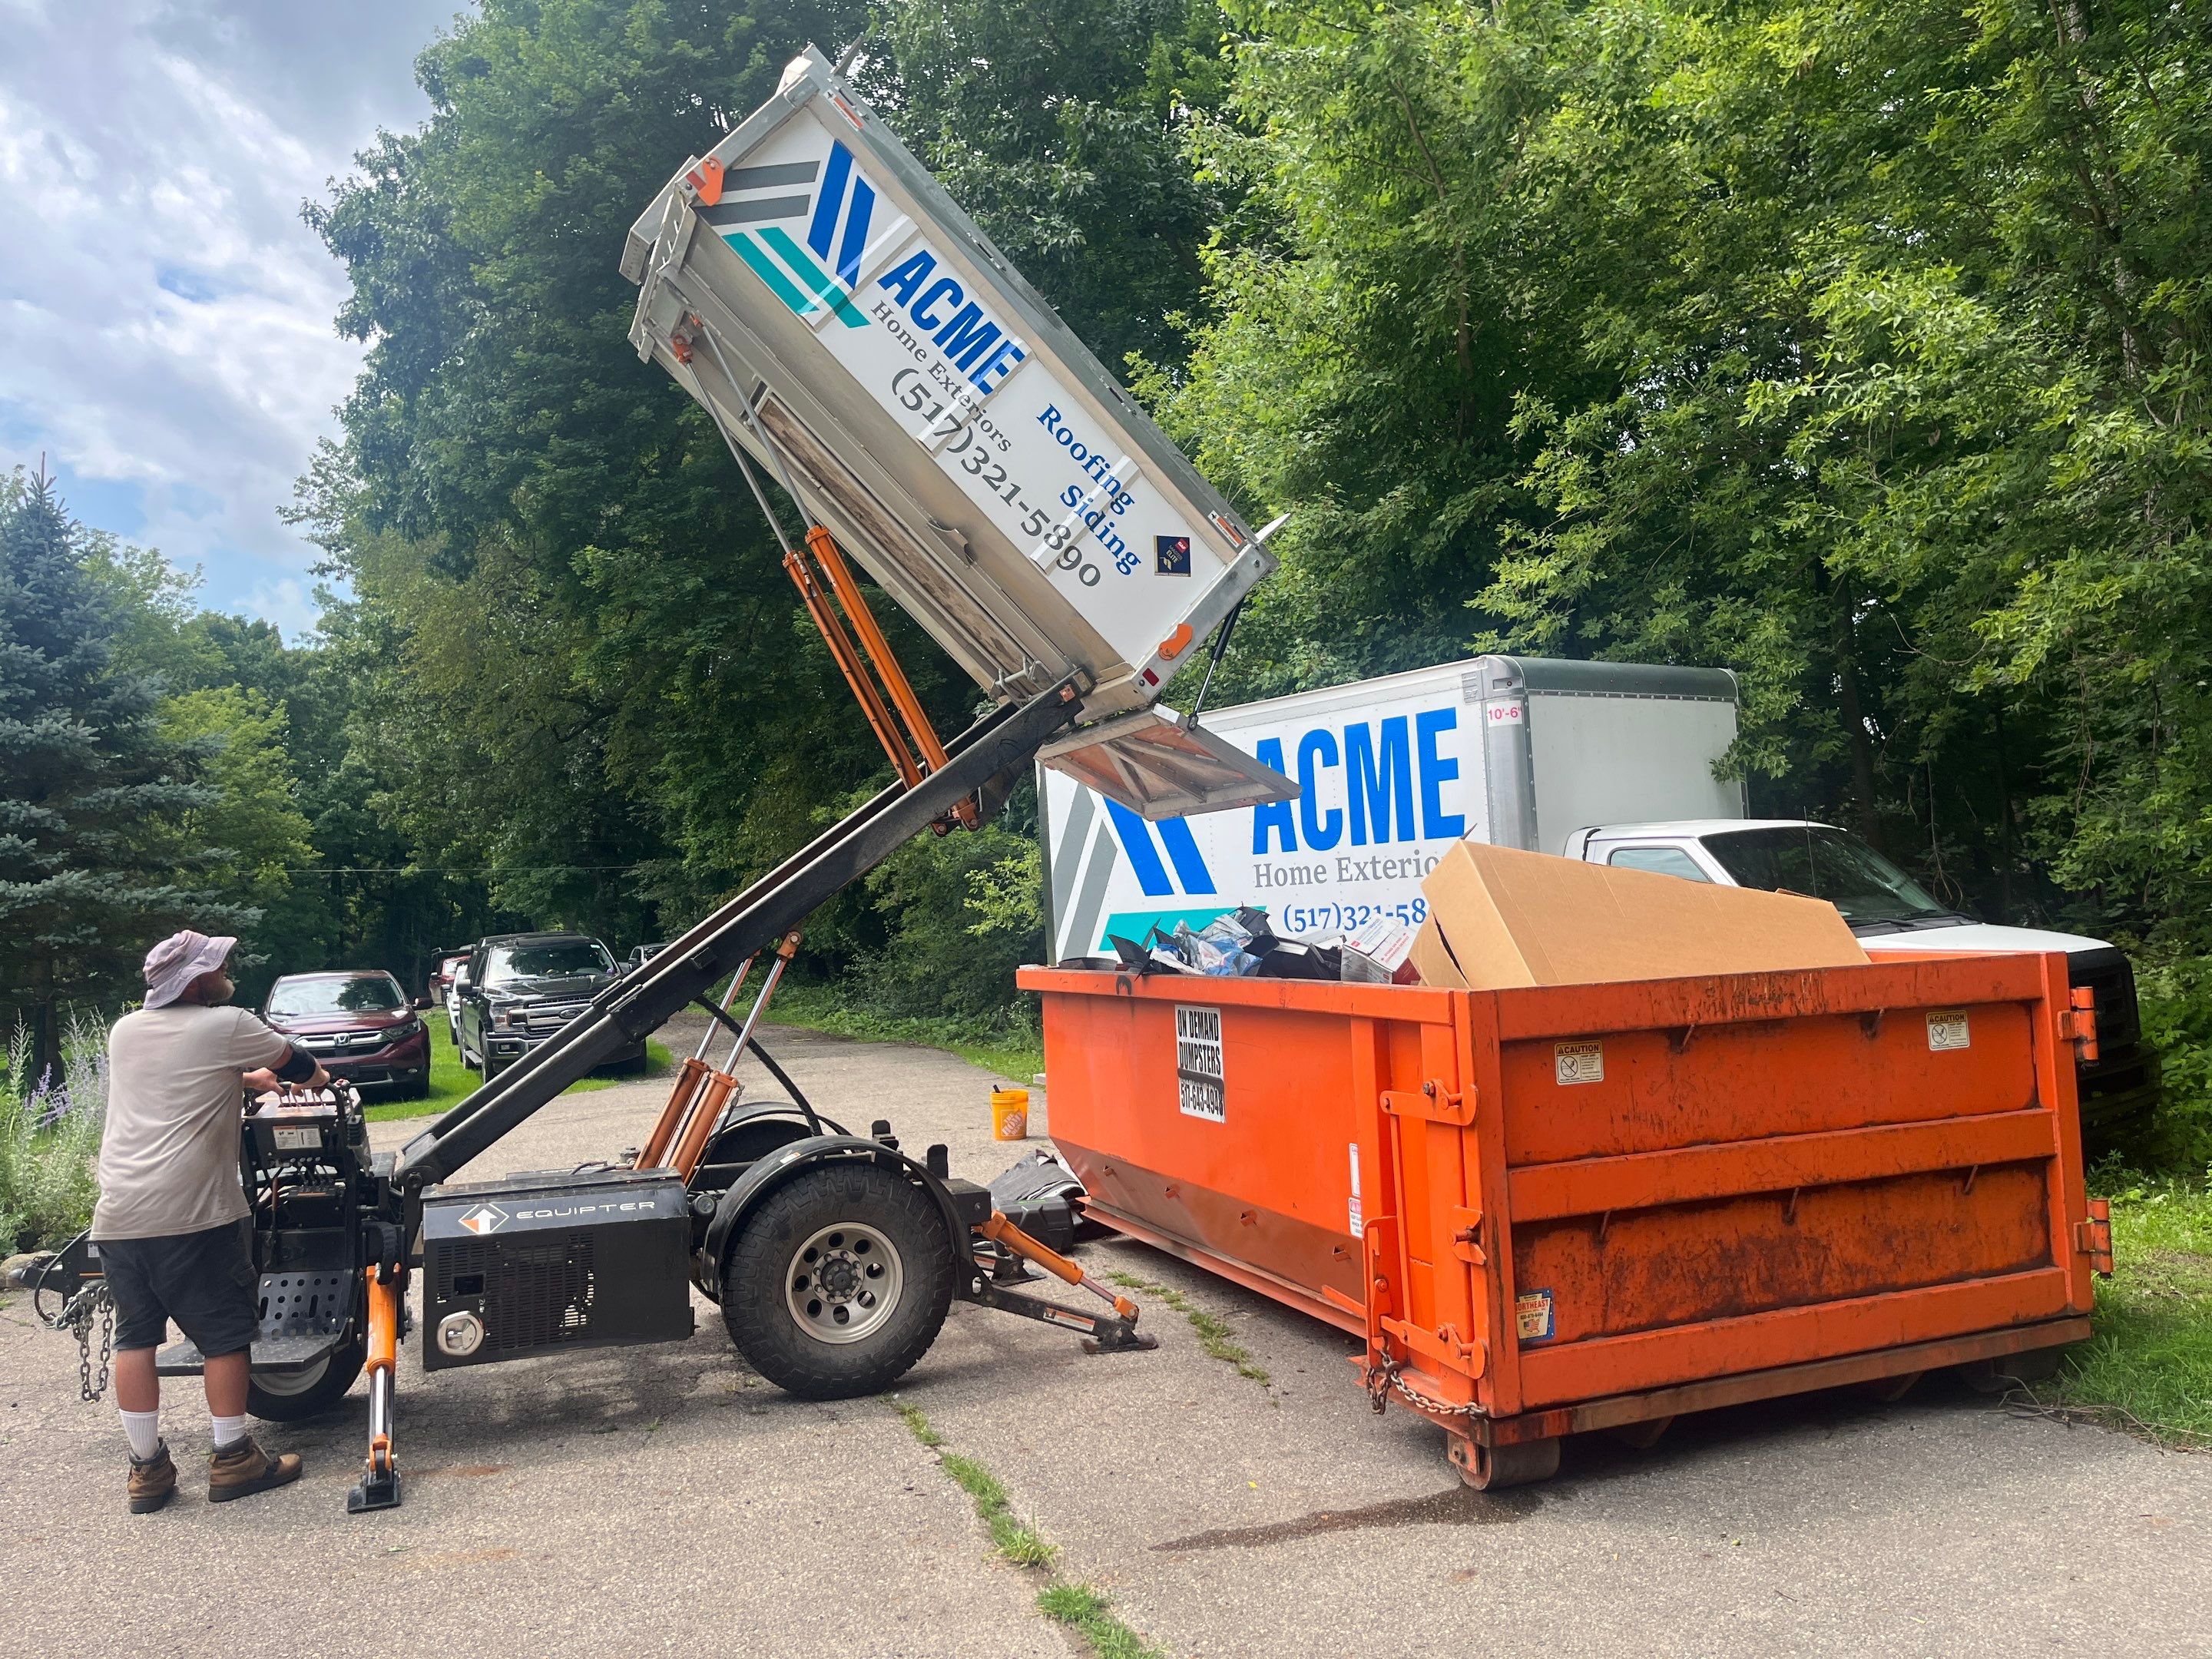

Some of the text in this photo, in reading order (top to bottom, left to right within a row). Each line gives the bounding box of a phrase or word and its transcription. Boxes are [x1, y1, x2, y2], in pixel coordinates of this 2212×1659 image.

[876, 249, 1025, 396] ACME
[871, 300, 1012, 452] Home Exteriors
[892, 368, 1101, 587] (517)321-5890
[1036, 403, 1134, 515] Roofing
[1060, 485, 1141, 575] Siding
[1253, 707, 1465, 854] ACME
[1253, 849, 1442, 888] Home Exterio
[1283, 897, 1427, 932] (517)321-58
[1177, 1008, 1219, 1041] ON DEMAND
[1935, 1014, 1965, 1022] CAUTION
[1178, 1041, 1221, 1075] DUMPSTERS
[1564, 1044, 1599, 1055] CAUTION
[516, 1201, 655, 1220] EQUIPTER
